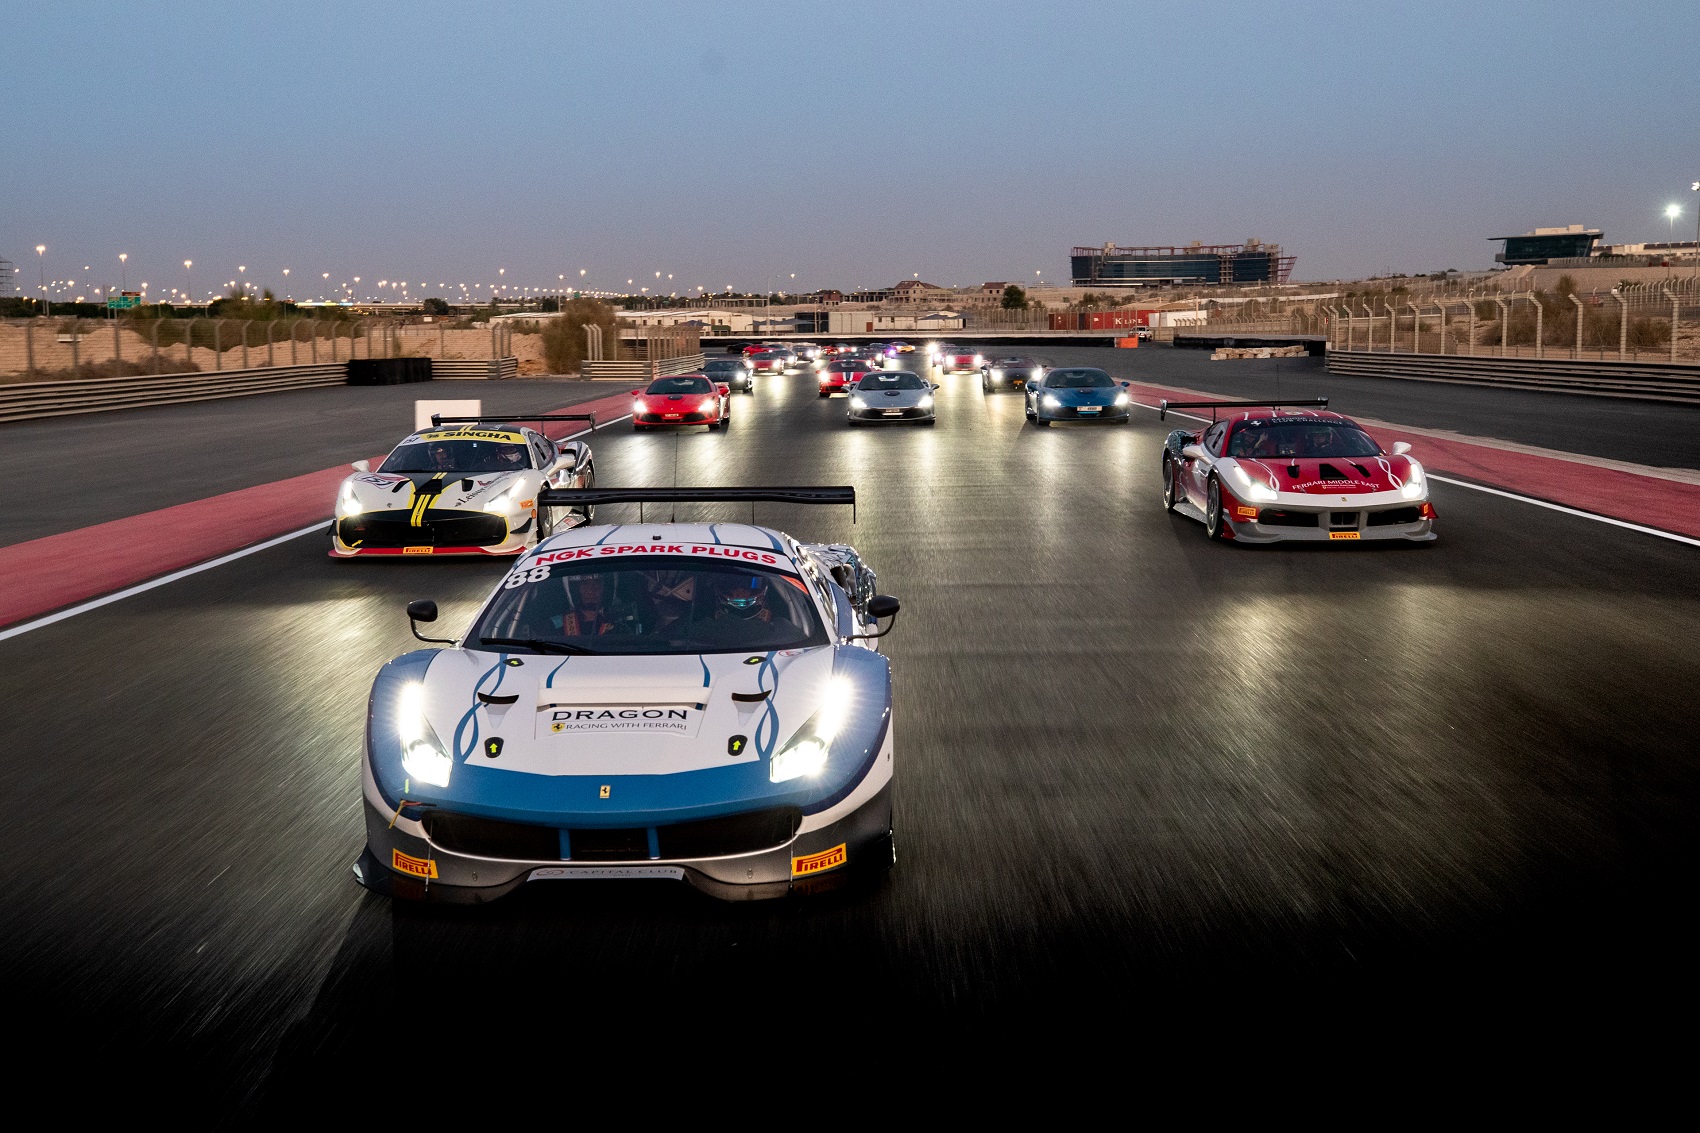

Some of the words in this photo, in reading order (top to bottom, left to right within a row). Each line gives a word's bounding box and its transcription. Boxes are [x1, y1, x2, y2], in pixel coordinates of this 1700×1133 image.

[443, 431, 511, 441] SINGHA
[1291, 480, 1326, 490] FERRARI
[1360, 480, 1380, 489] EAST
[535, 548, 595, 566] NGK
[600, 545, 684, 555] SPARK
[691, 547, 777, 565] PLUGS
[504, 565, 551, 590] 88
[552, 709, 688, 721] DRAGON
[566, 722, 608, 730] RACING
[643, 722, 687, 731] FERRARI
[395, 852, 433, 876] PIRELLI
[796, 847, 843, 872] PIRELLI
